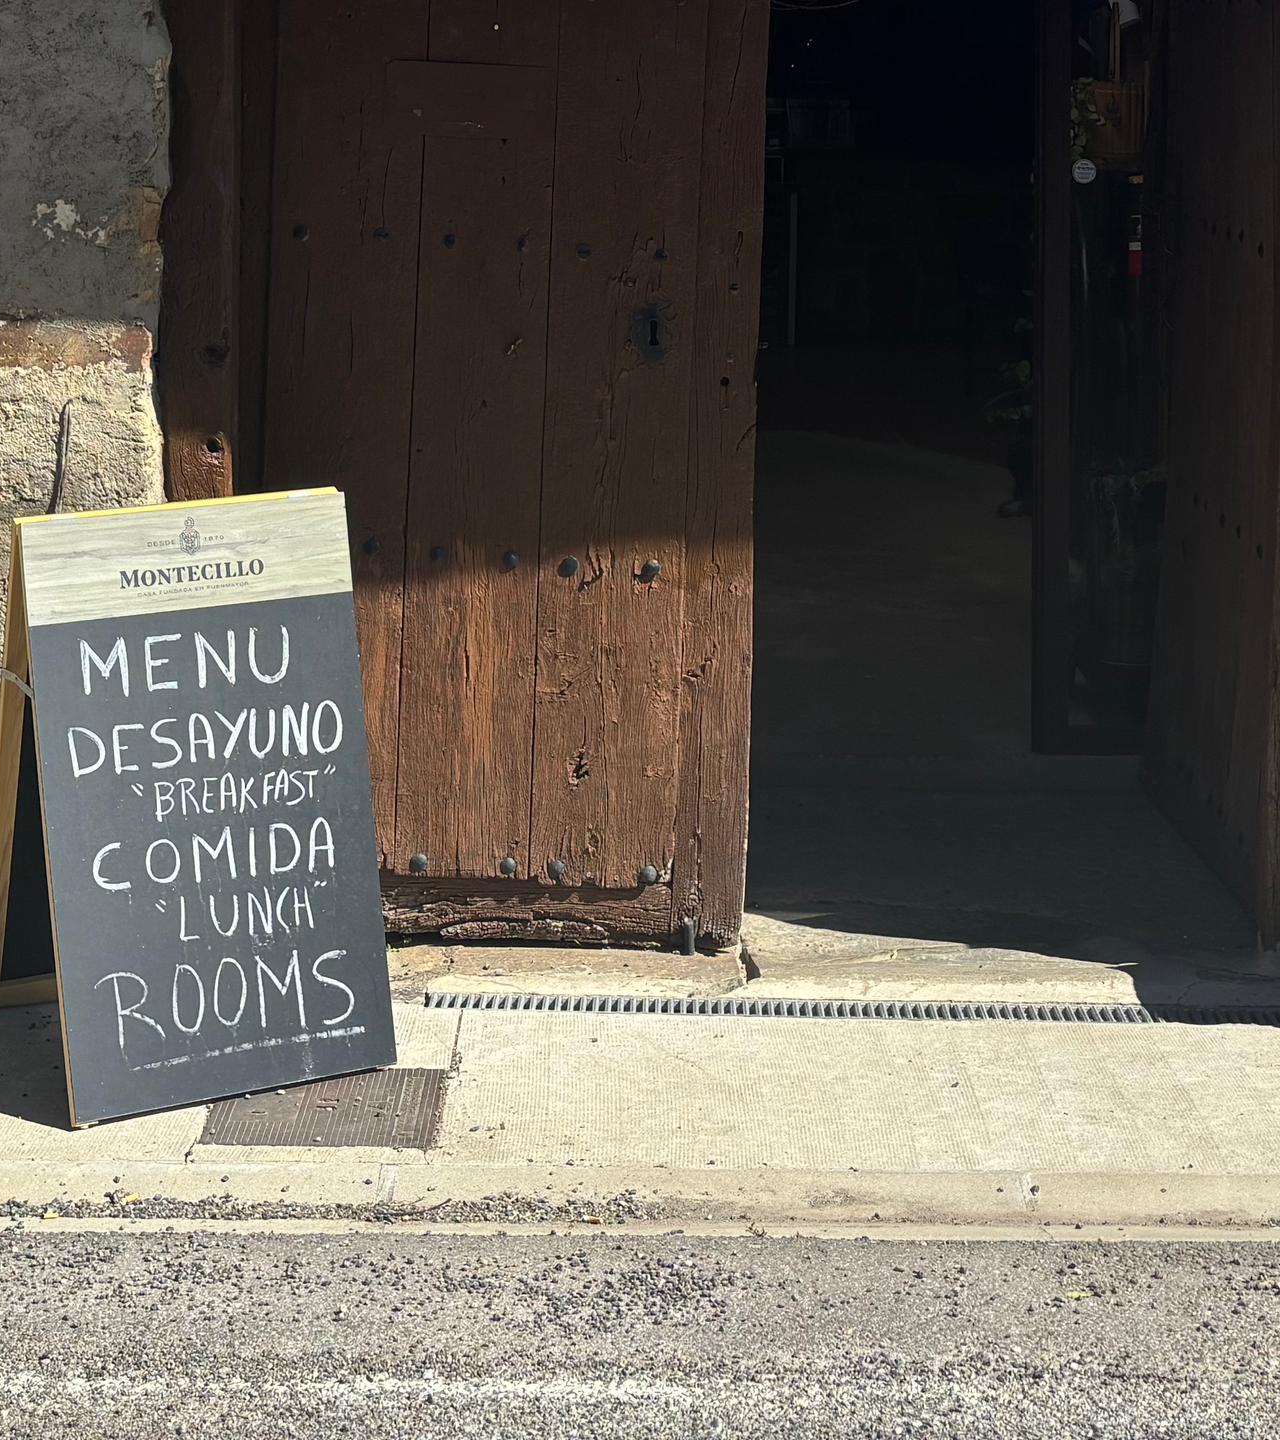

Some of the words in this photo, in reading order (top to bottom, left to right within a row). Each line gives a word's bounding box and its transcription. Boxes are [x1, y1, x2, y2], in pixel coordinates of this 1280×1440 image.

[119, 558, 265, 590] MONTECILLO
[146, 539, 176, 548] DESDE
[78, 624, 290, 697] MENU
[67, 699, 344, 778] DESAYUNO
[93, 817, 335, 891] COMIDA
[94, 950, 355, 1049] ROOMS
